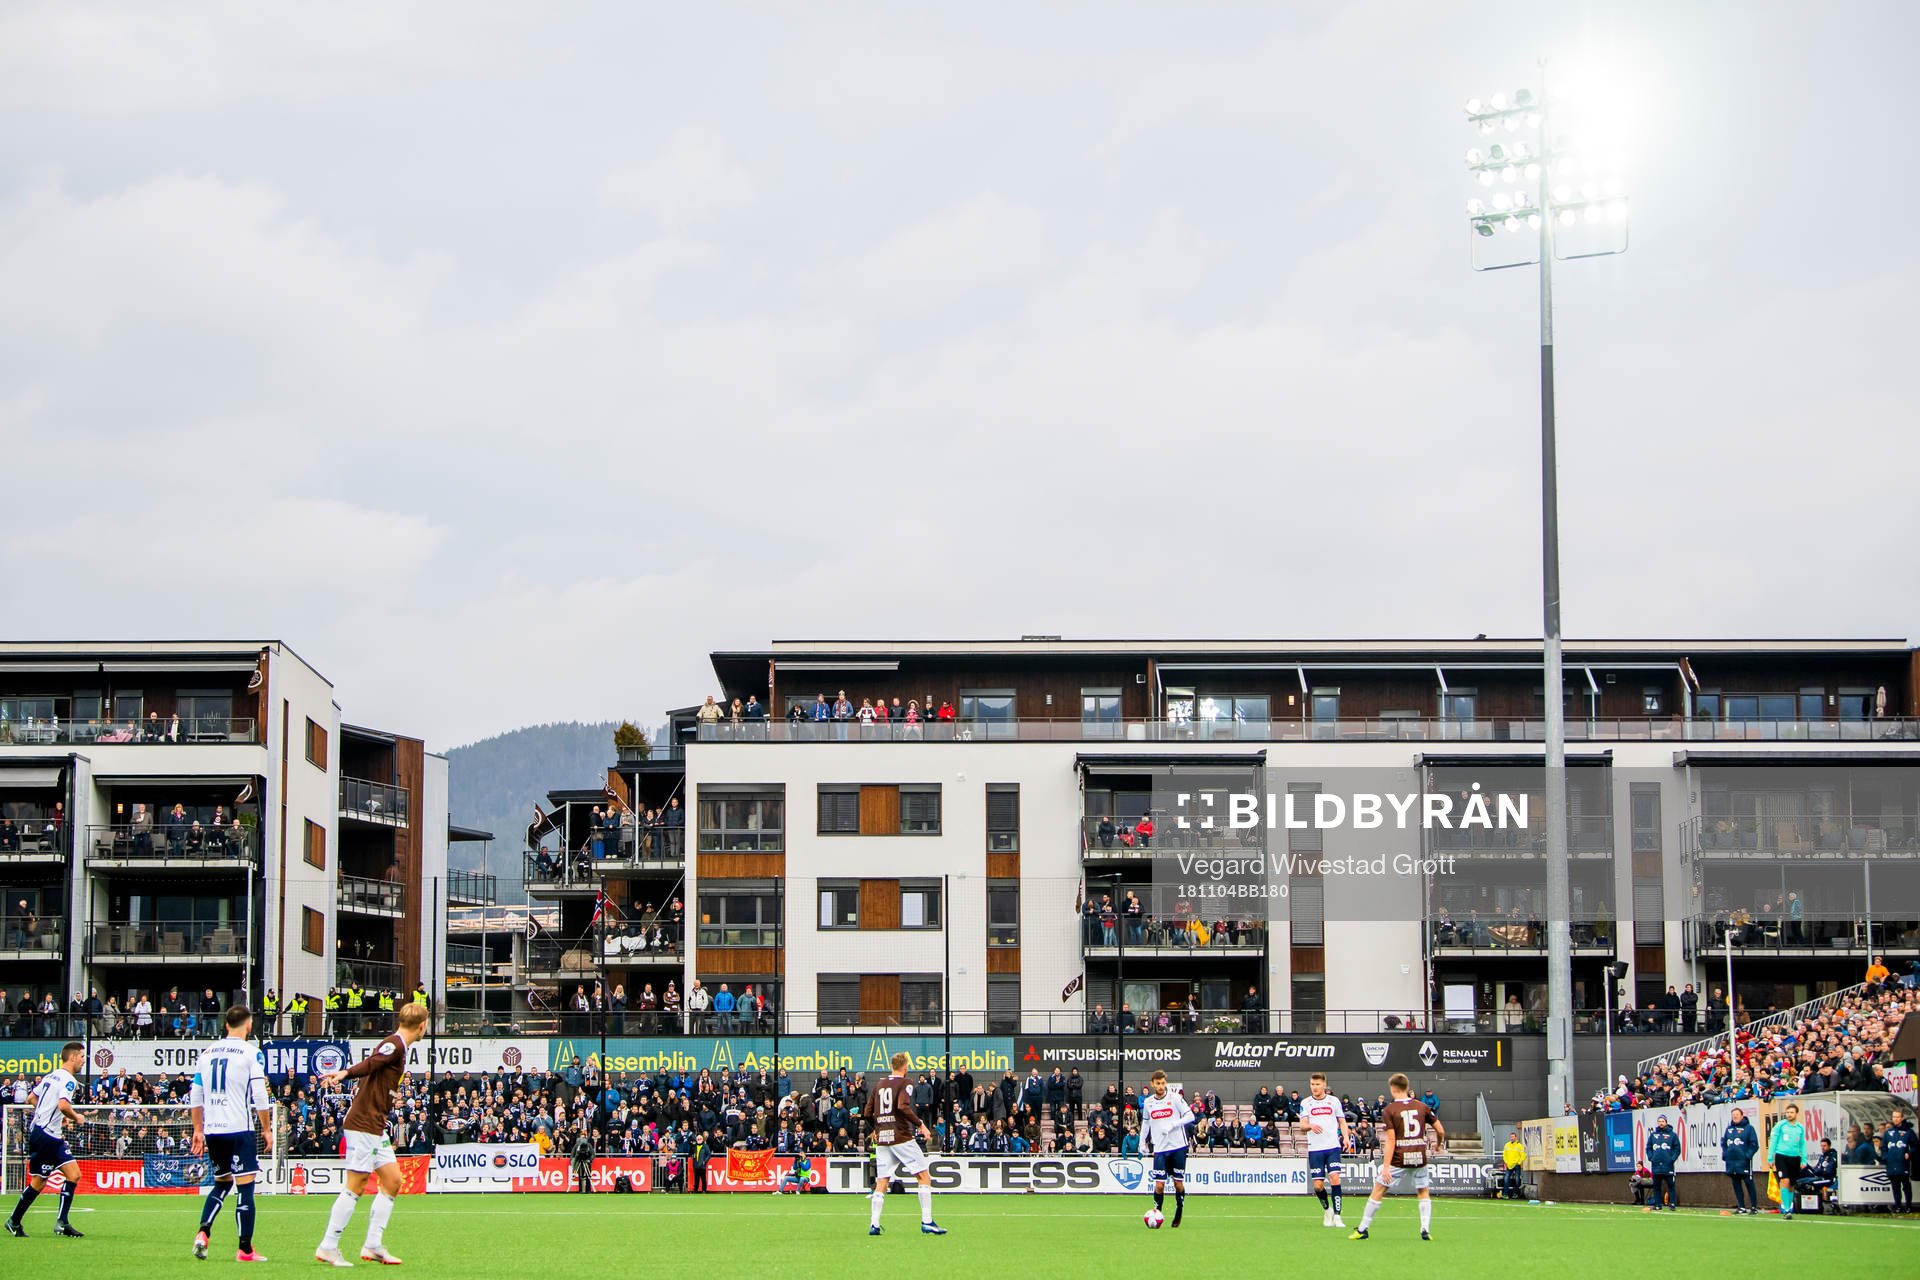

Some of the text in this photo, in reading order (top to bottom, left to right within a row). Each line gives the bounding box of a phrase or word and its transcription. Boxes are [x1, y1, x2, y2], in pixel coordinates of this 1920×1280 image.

[1043, 1049, 1182, 1061] MITSUBISHI MOTORS
[1215, 1041, 1336, 1057] Motor Forum
[1443, 1050, 1489, 1058] RENAULT
[1215, 1060, 1262, 1068] DRAMMEN
[210, 1058, 228, 1094] 11
[38, 1082, 51, 1108] 7
[878, 1088, 893, 1114] 19
[1400, 1110, 1421, 1138] 15
[437, 1154, 487, 1169] VIKING
[968, 1160, 1100, 1189] TESS
[1195, 1173, 1209, 1185] og
[1213, 1170, 1287, 1183] Gudbrandsen
[1291, 1170, 1306, 1183] AS
[1427, 1163, 1494, 1179] RENING
